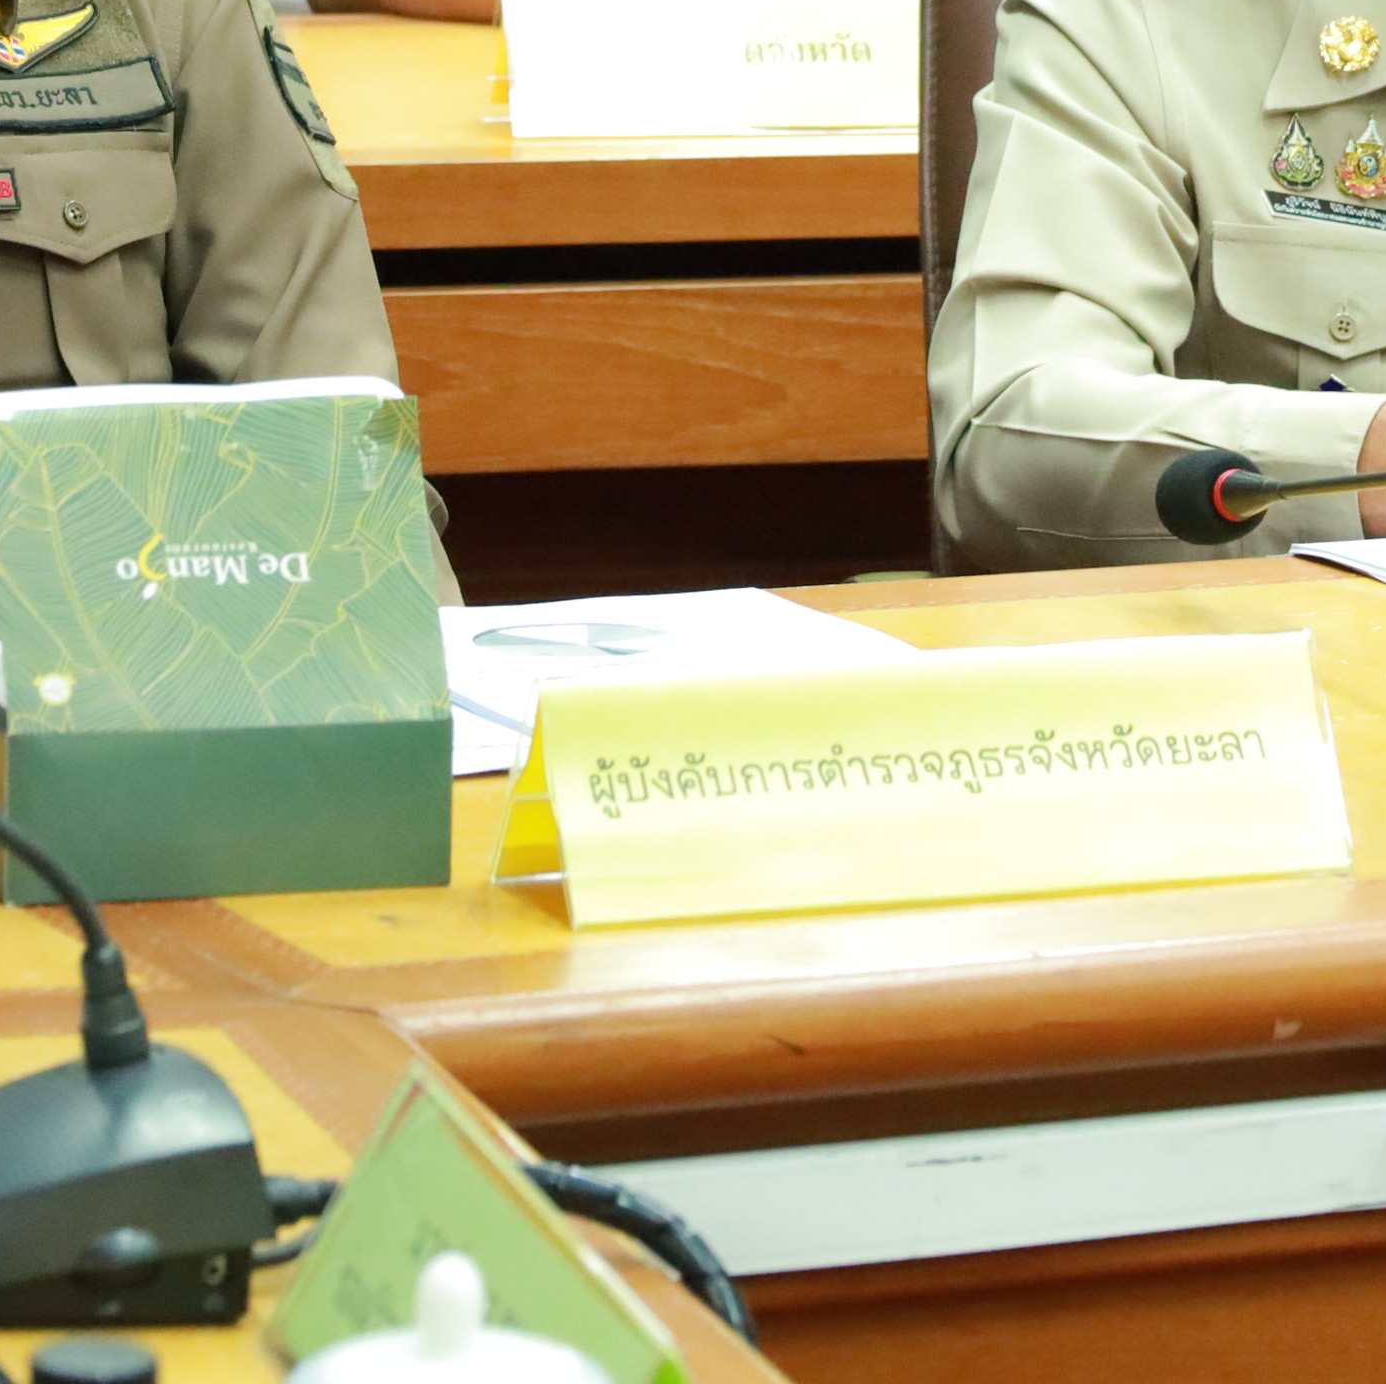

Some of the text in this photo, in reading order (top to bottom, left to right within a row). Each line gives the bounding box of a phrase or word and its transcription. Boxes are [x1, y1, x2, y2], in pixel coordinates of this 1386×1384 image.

[257, 551, 311, 583] De
[588, 723, 1268, 820] ผู้บังคับการตำรวจภูธรจังหวัดยะลา
